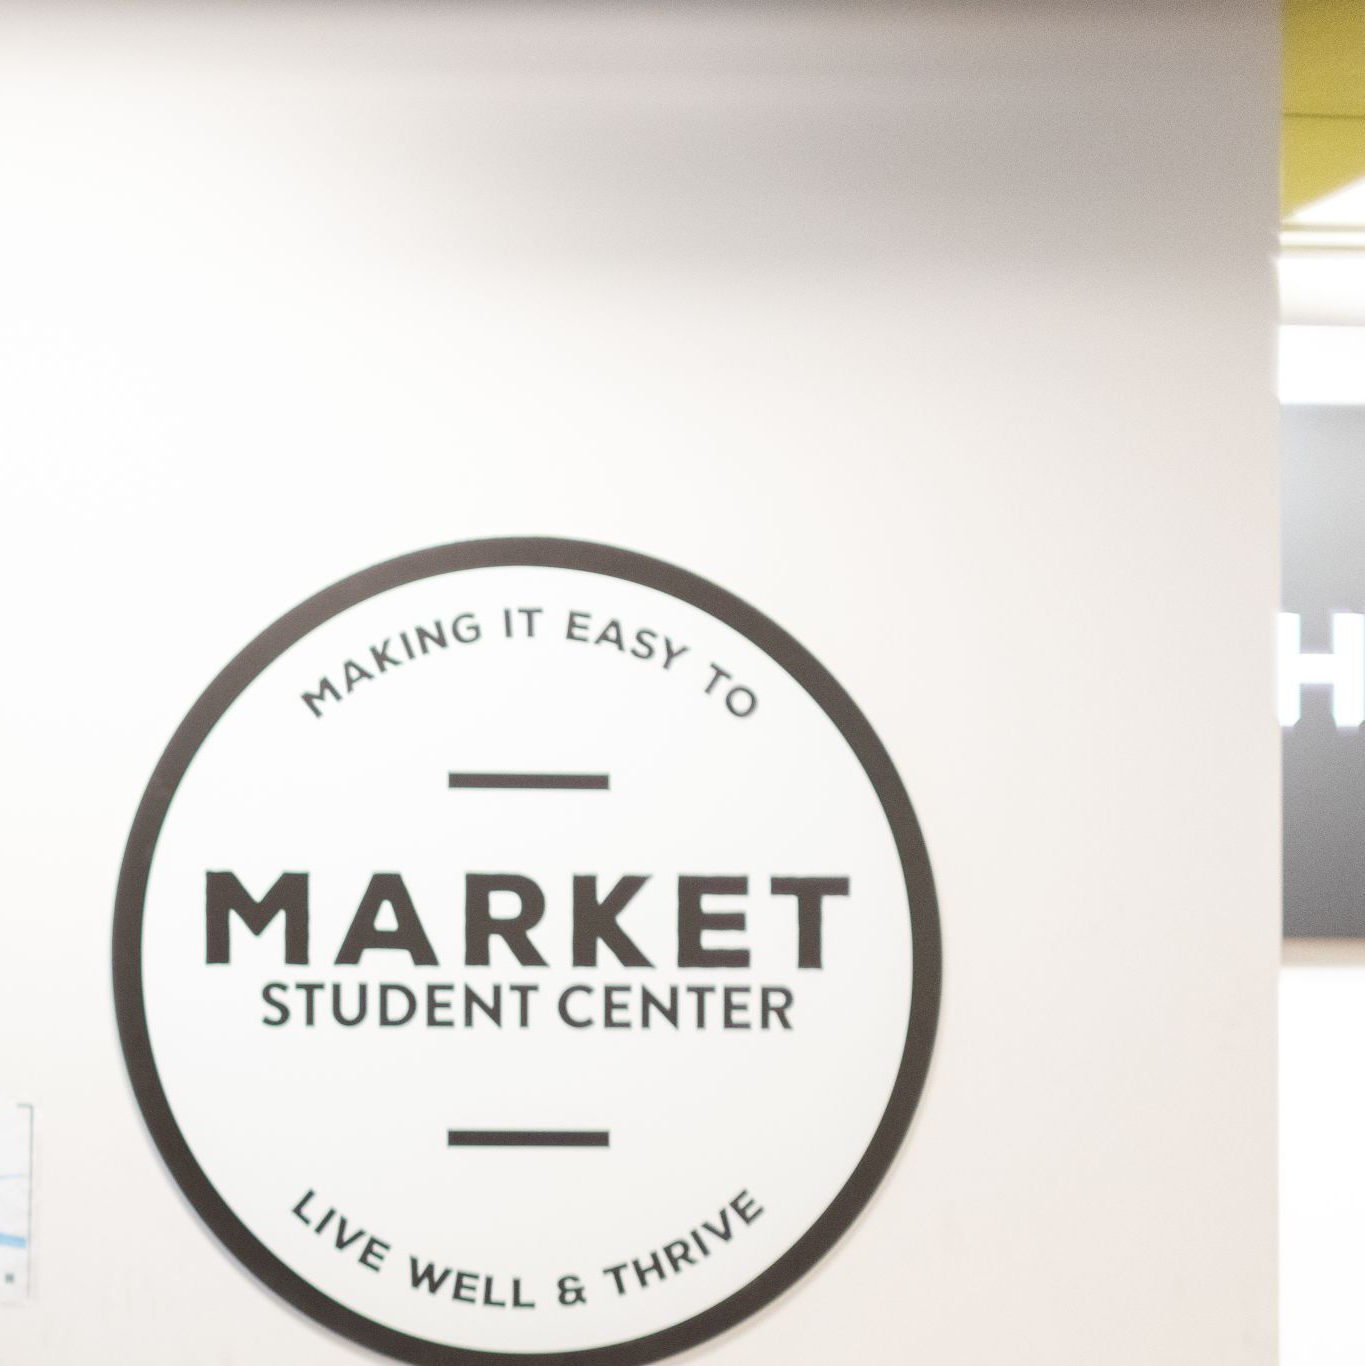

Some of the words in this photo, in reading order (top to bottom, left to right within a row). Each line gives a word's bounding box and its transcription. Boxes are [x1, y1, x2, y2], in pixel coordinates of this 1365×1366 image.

[301, 611, 482, 718] MAKING
[503, 607, 542, 638] IT
[566, 609, 689, 672] EASY
[703, 662, 759, 719] TO
[205, 870, 851, 969] MARKET
[261, 982, 540, 1029] STUDENT
[556, 984, 794, 1031] CENTER
[291, 1189, 392, 1273] LIVE
[408, 1255, 536, 1309] WELL
[557, 1274, 588, 1306] &
[603, 1188, 765, 1298] THRIVE
